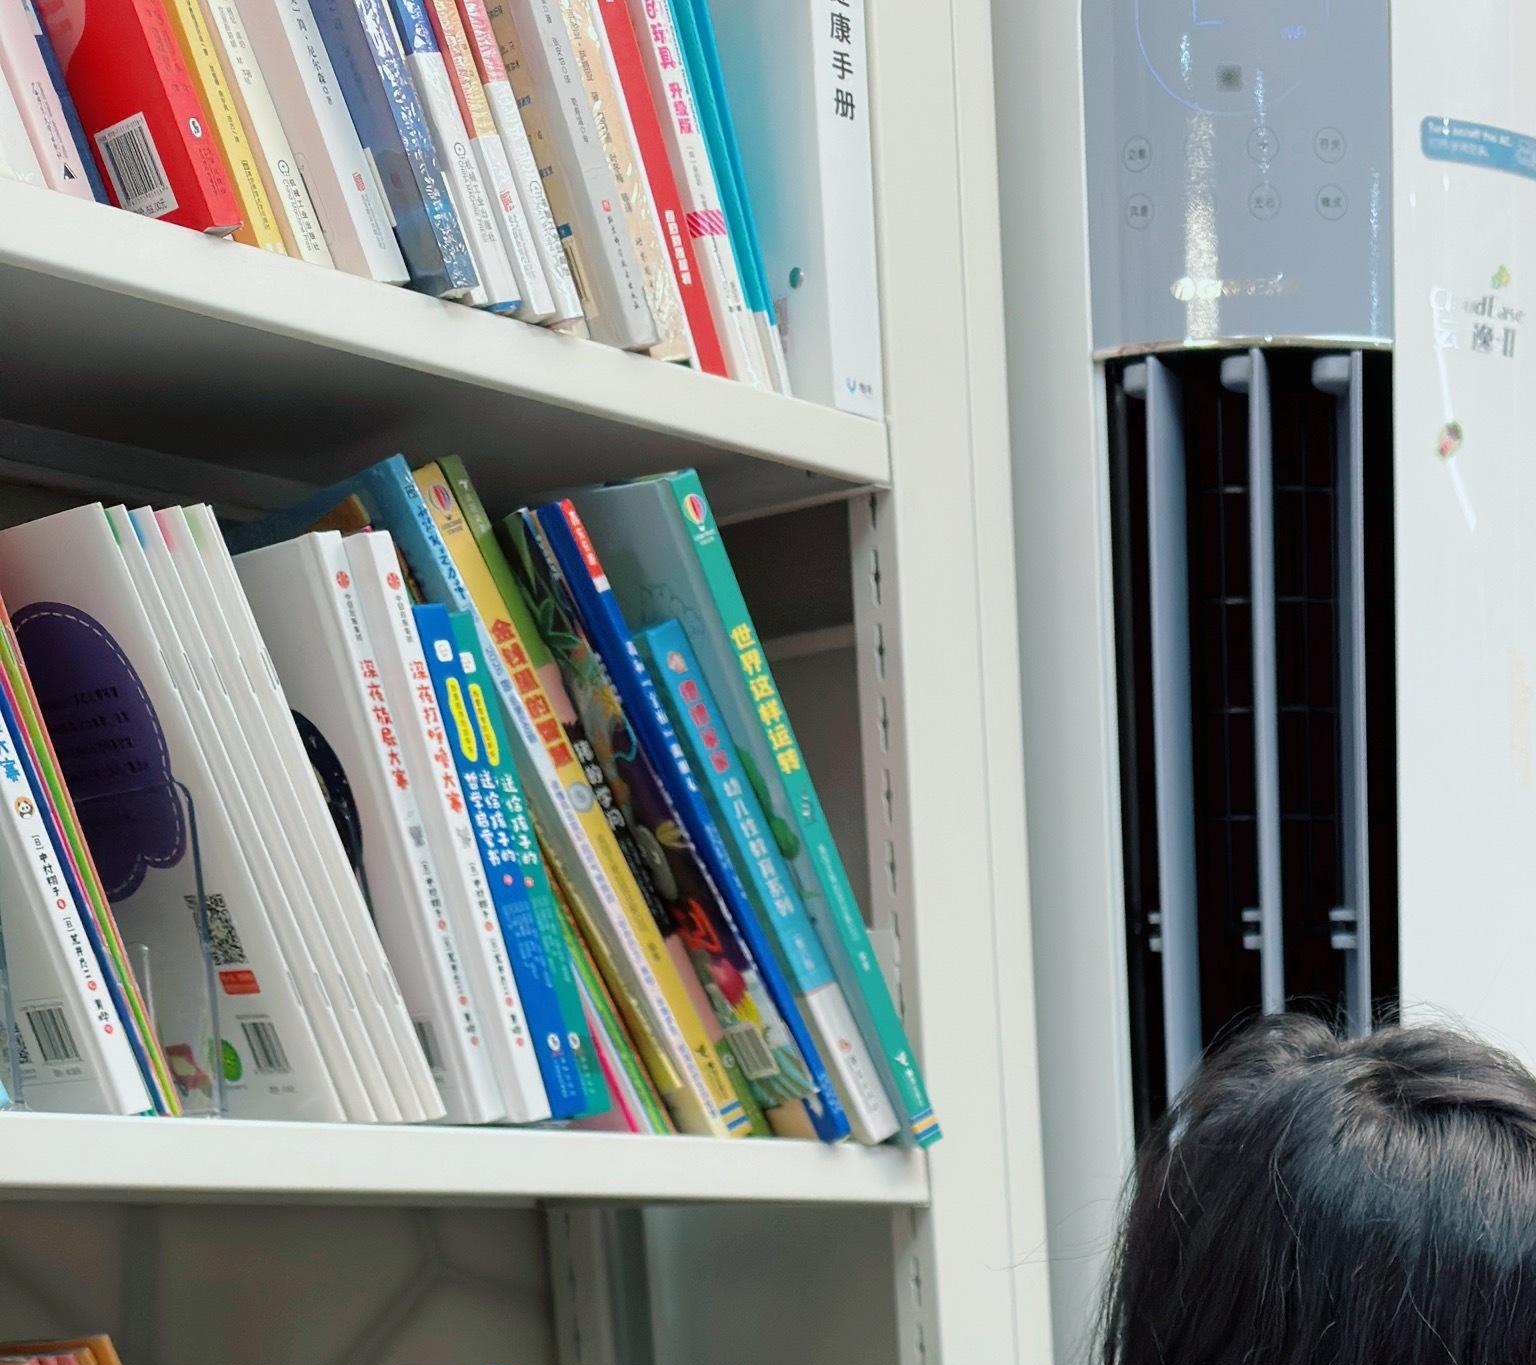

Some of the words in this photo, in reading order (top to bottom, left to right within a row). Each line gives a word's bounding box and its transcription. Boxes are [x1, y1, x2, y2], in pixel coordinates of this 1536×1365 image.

[729, 622, 801, 775] 世界这样运转
